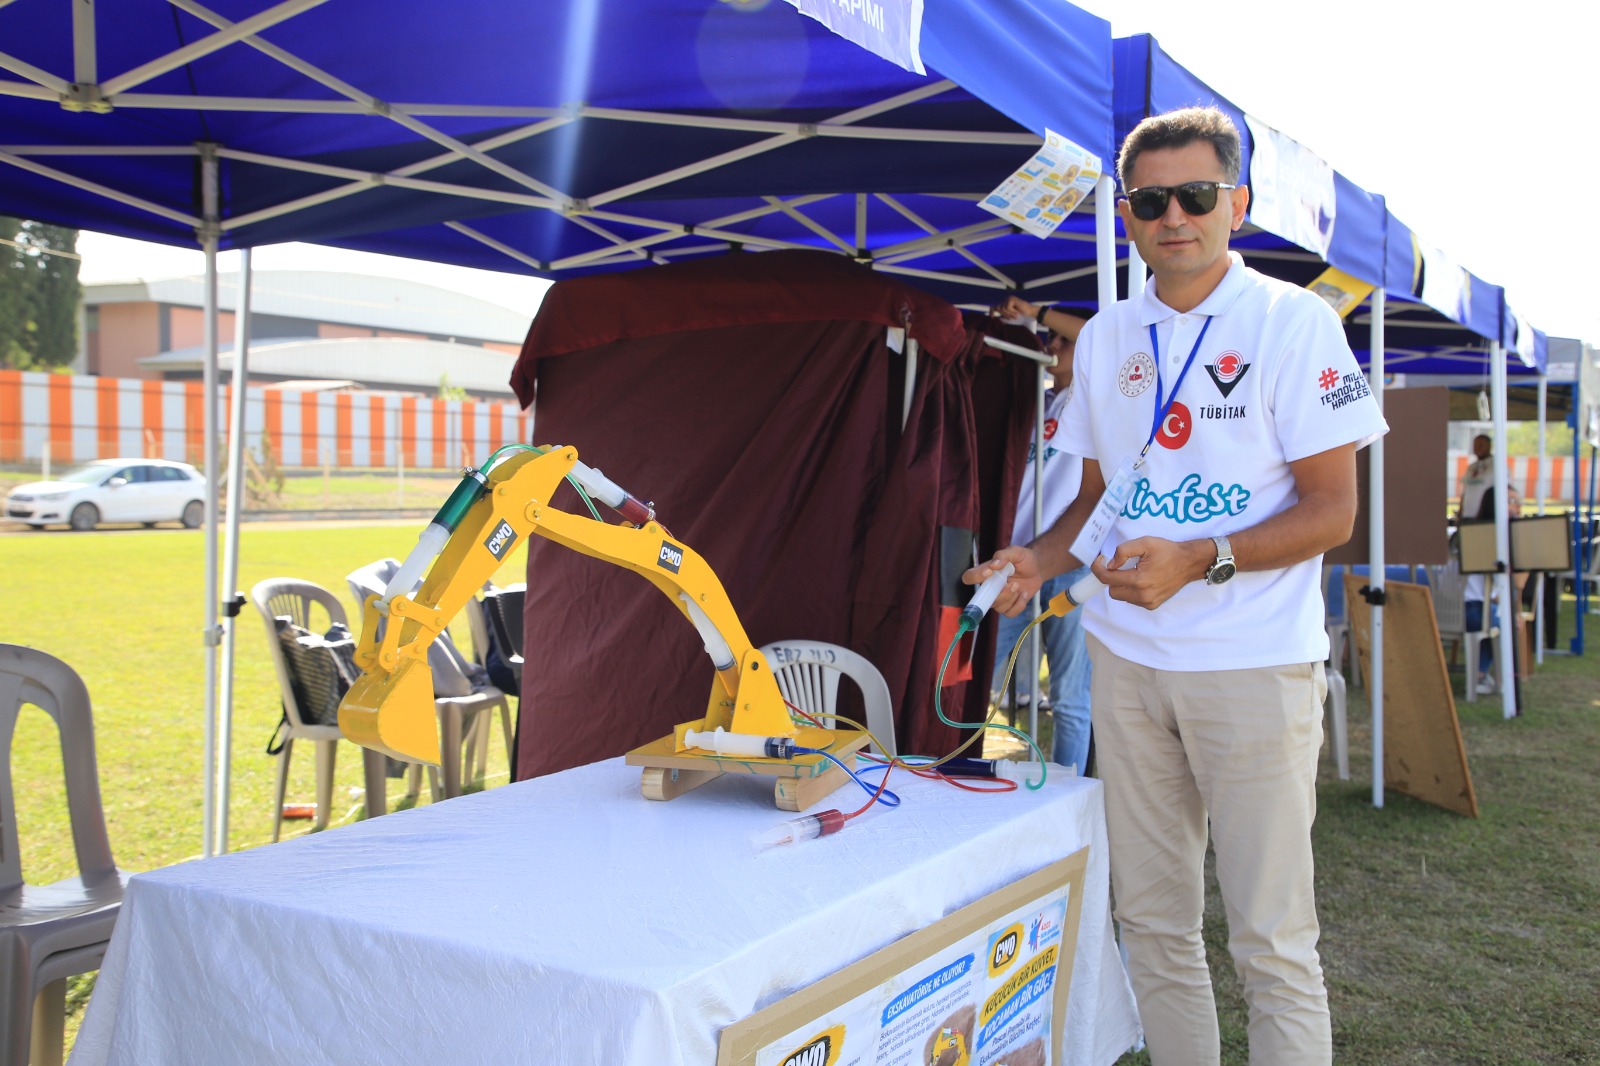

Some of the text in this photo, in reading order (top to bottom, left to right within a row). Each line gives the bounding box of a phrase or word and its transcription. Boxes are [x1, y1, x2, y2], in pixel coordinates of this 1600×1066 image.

[832, 0, 884, 33] PIMI
[1200, 404, 1246, 419] TÜBİTAK
[488, 523, 513, 555] CWO
[660, 546, 682, 567] CWO
[995, 934, 1016, 963] CWO
[933, 974, 942, 990] NE
[1018, 965, 1030, 986] BİR
[1020, 984, 1032, 1008] BİR
[783, 1041, 827, 1066] WO
